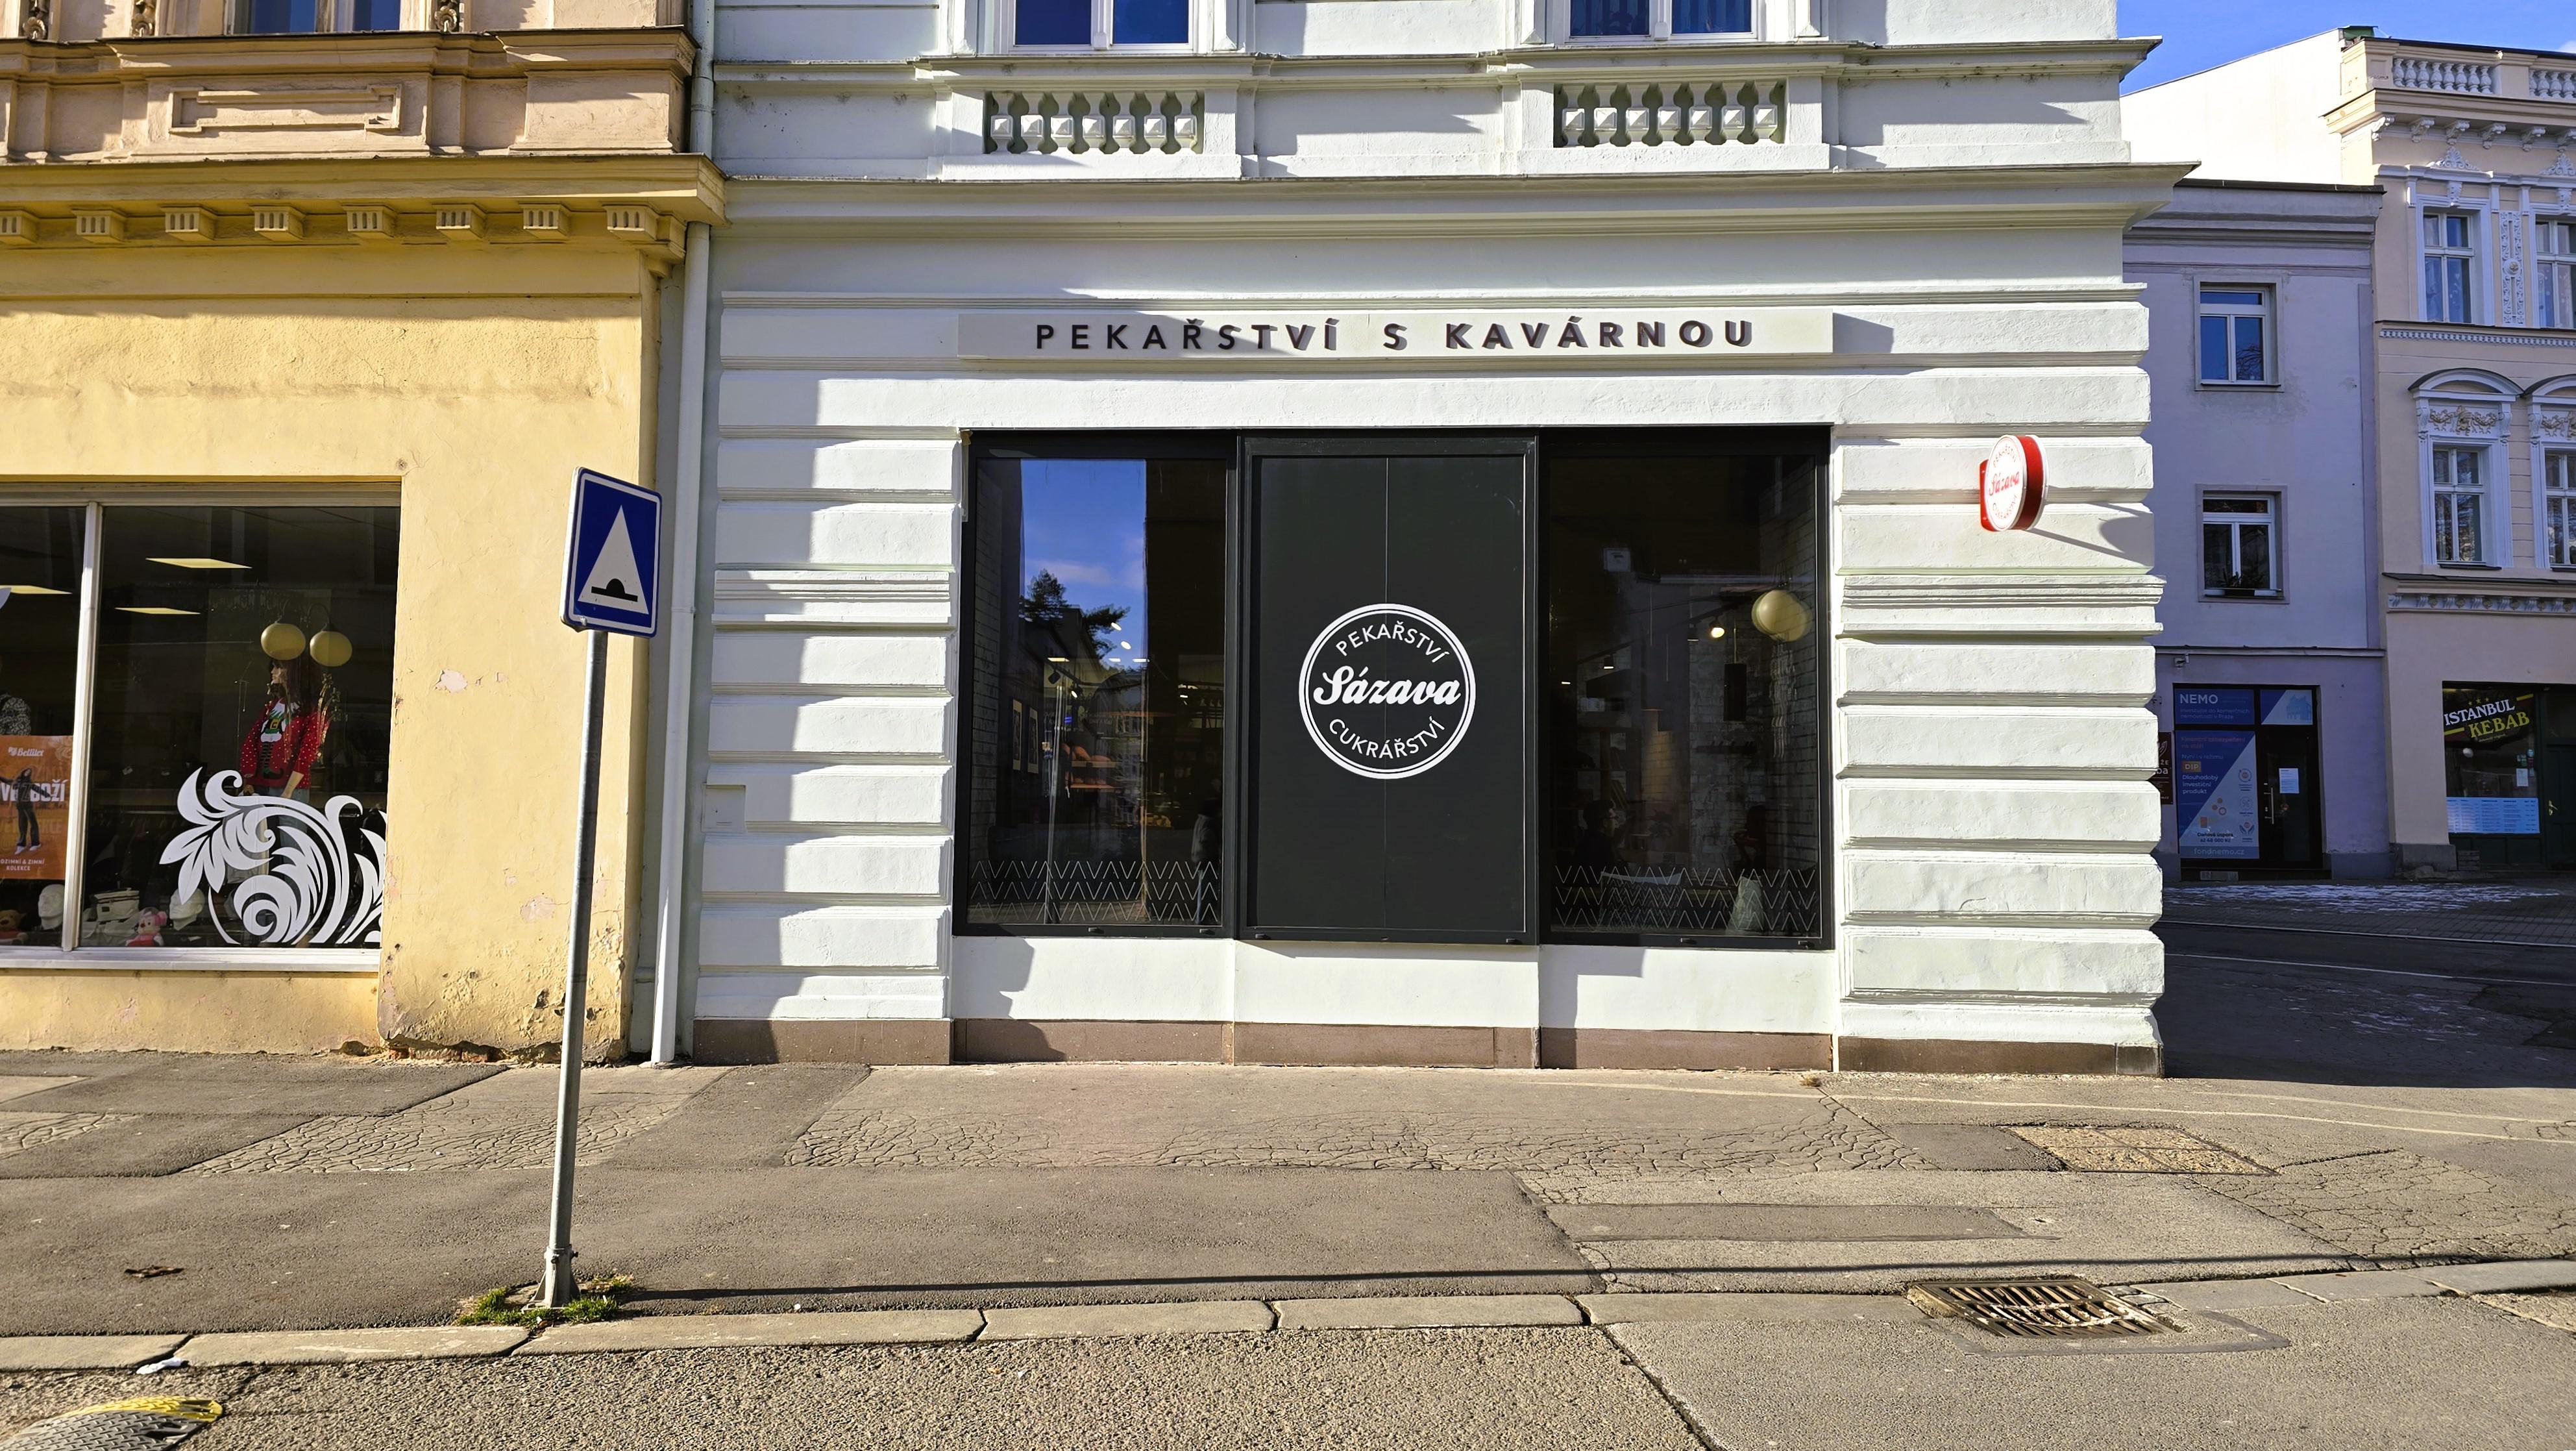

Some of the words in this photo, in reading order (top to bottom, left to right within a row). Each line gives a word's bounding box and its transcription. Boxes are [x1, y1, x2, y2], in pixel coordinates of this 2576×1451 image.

[1037, 318, 1340, 351] PEKAŘSTVÍ
[1383, 323, 1407, 351] S
[1445, 316, 1753, 349] KAVÁRNOU
[1989, 471, 2020, 496] Sázava
[1336, 620, 1450, 663] PEKAŘSTVÍ
[1313, 665, 1462, 705] Sázava
[2180, 694, 2218, 704] NEMO
[2444, 699, 2516, 726] ISTANBUL
[2468, 712, 2530, 738] KEBAB
[1329, 716, 1445, 759] CUKRÁŘSTVÍ
